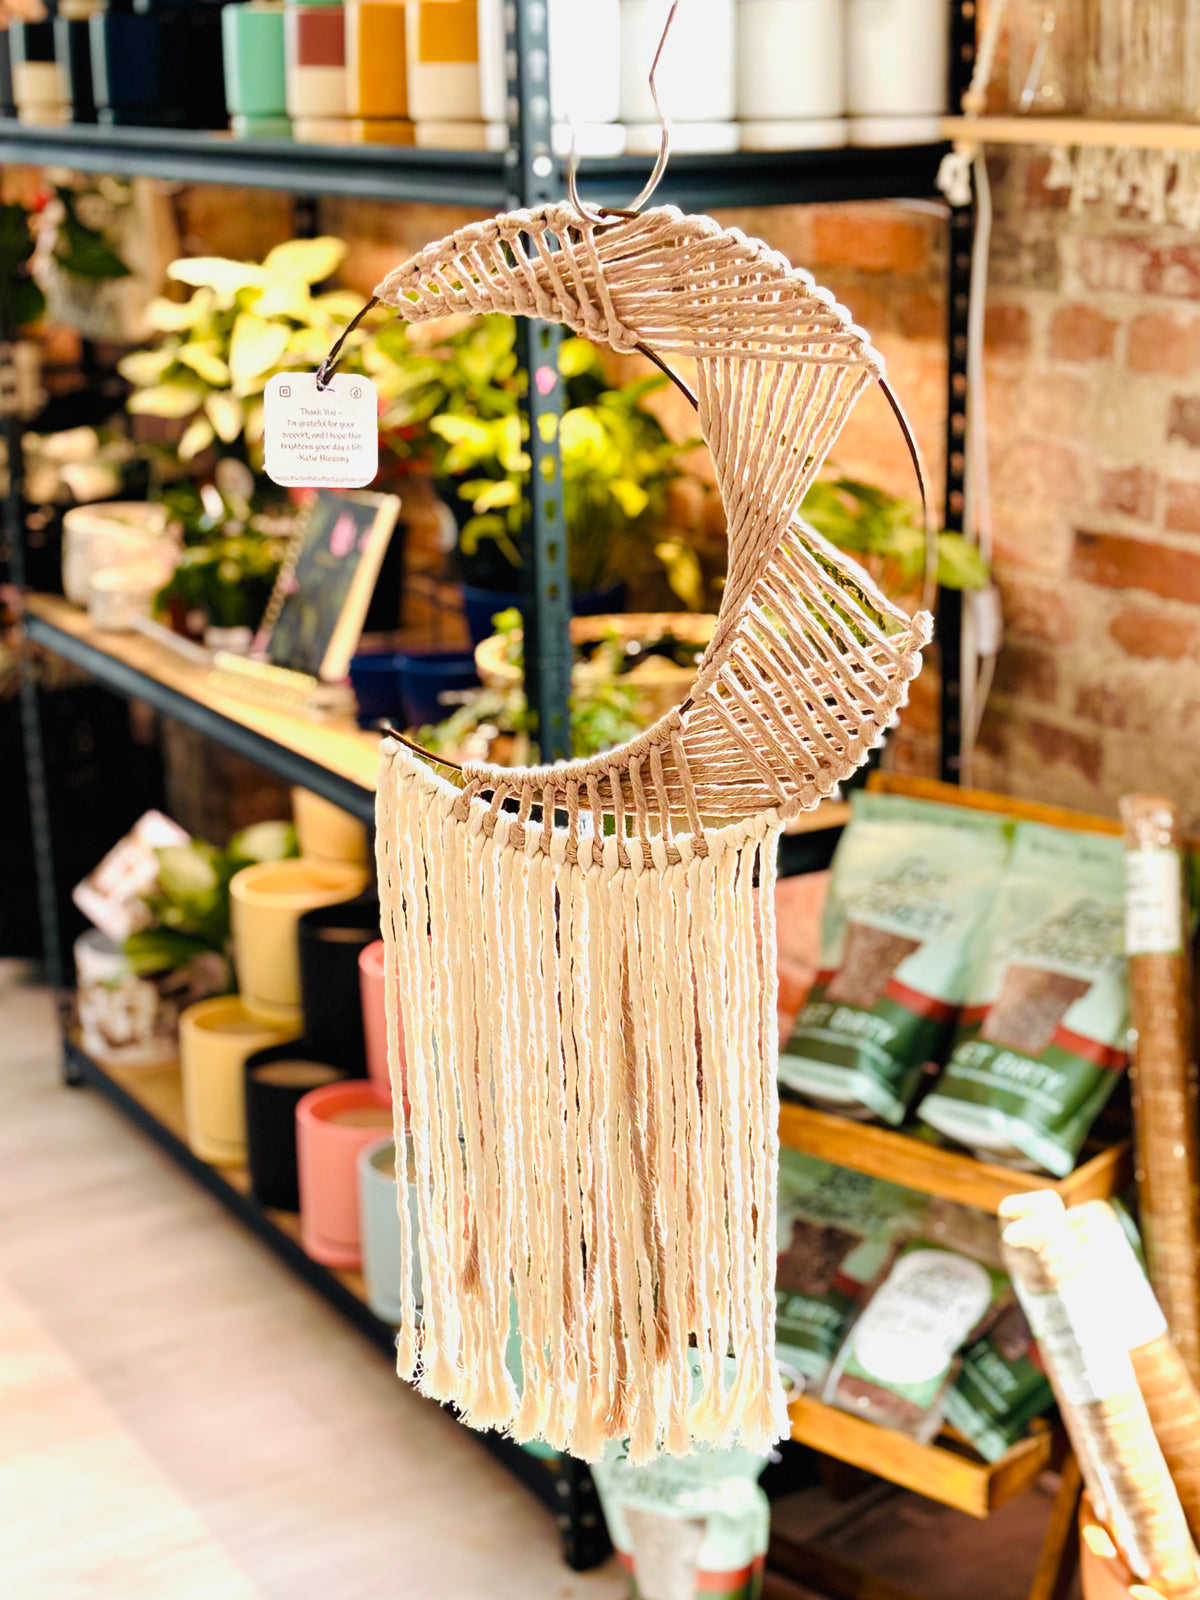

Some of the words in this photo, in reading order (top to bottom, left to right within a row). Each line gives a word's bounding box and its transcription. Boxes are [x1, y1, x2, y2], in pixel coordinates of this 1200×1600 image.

[299, 407, 321, 415] Thank
[322, 408, 337, 416] You
[327, 419, 338, 428] for
[339, 421, 355, 430] your
[330, 431, 346, 440] hope
[348, 431, 362, 440] this
[314, 444, 331, 453] your
[333, 442, 345, 452] day
